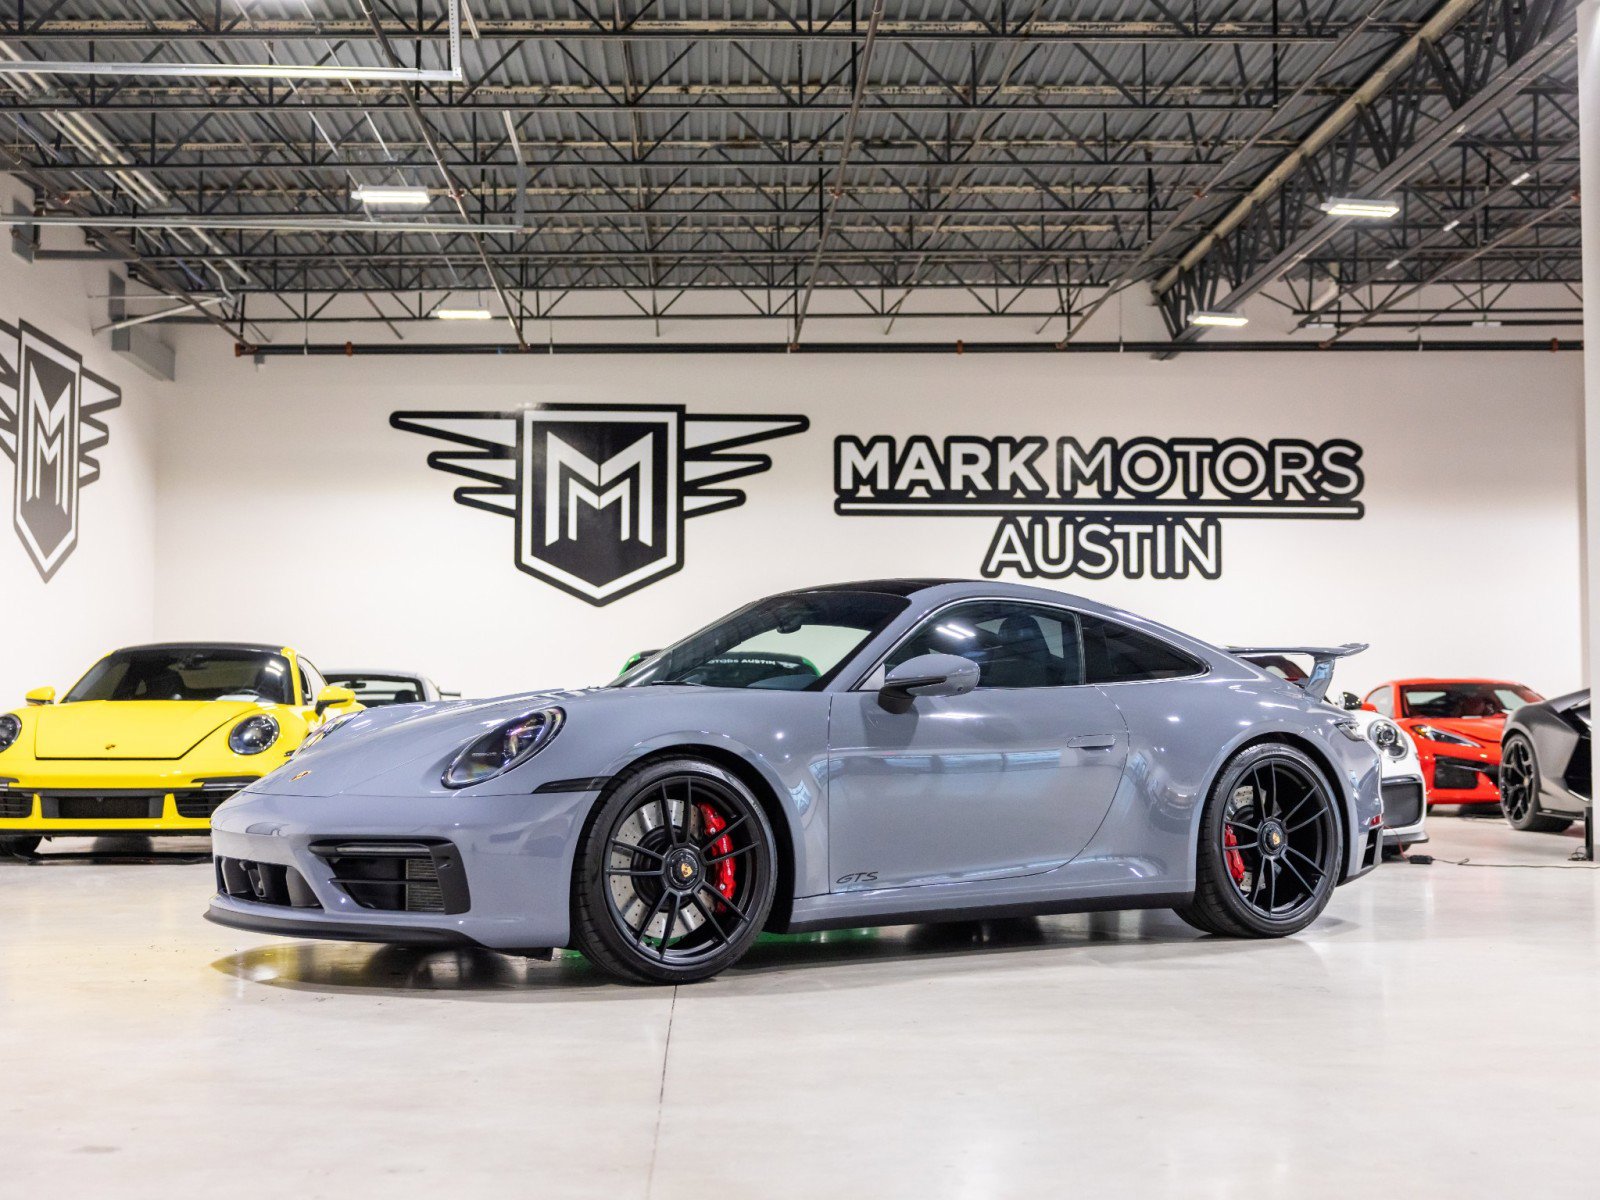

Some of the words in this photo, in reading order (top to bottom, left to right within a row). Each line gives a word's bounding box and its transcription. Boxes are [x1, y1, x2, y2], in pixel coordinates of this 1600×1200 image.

[838, 440, 1045, 493] MARK
[1060, 441, 1361, 496] MOTORS
[984, 521, 1218, 576] AUSTIN
[836, 871, 879, 884] GTS
